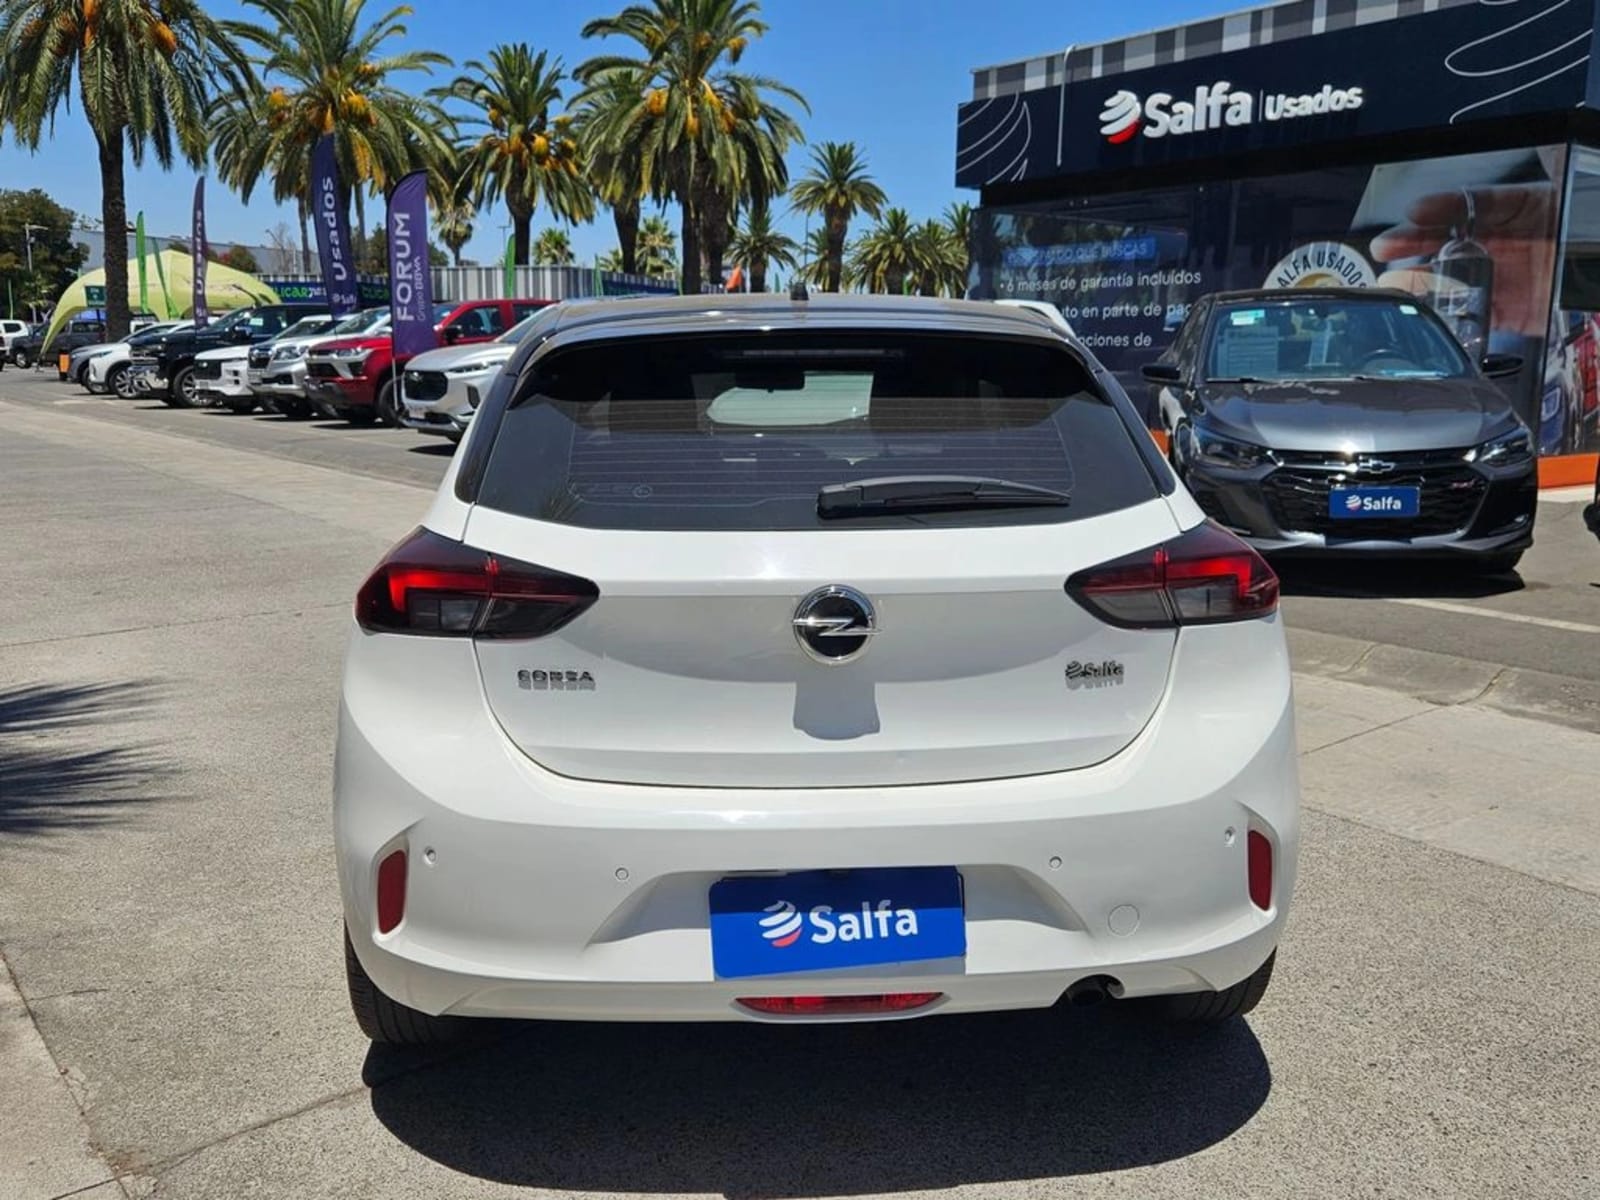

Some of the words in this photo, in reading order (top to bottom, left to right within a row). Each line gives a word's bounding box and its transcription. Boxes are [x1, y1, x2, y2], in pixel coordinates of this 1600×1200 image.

[1143, 81, 1253, 138] Salfa
[1264, 84, 1363, 121] Usados
[322, 177, 347, 281] Usados
[394, 212, 415, 321] FORUM
[413, 256, 424, 290] BBVA
[1018, 279, 1056, 291] meses
[1060, 276, 1076, 290] de
[1080, 273, 1133, 292] garantía
[1082, 306, 1098, 318] en
[1103, 304, 1139, 320] parte
[1143, 303, 1161, 316] de
[1134, 332, 1152, 346] de
[1363, 496, 1402, 511] Salfa
[809, 899, 918, 944] Salfa
